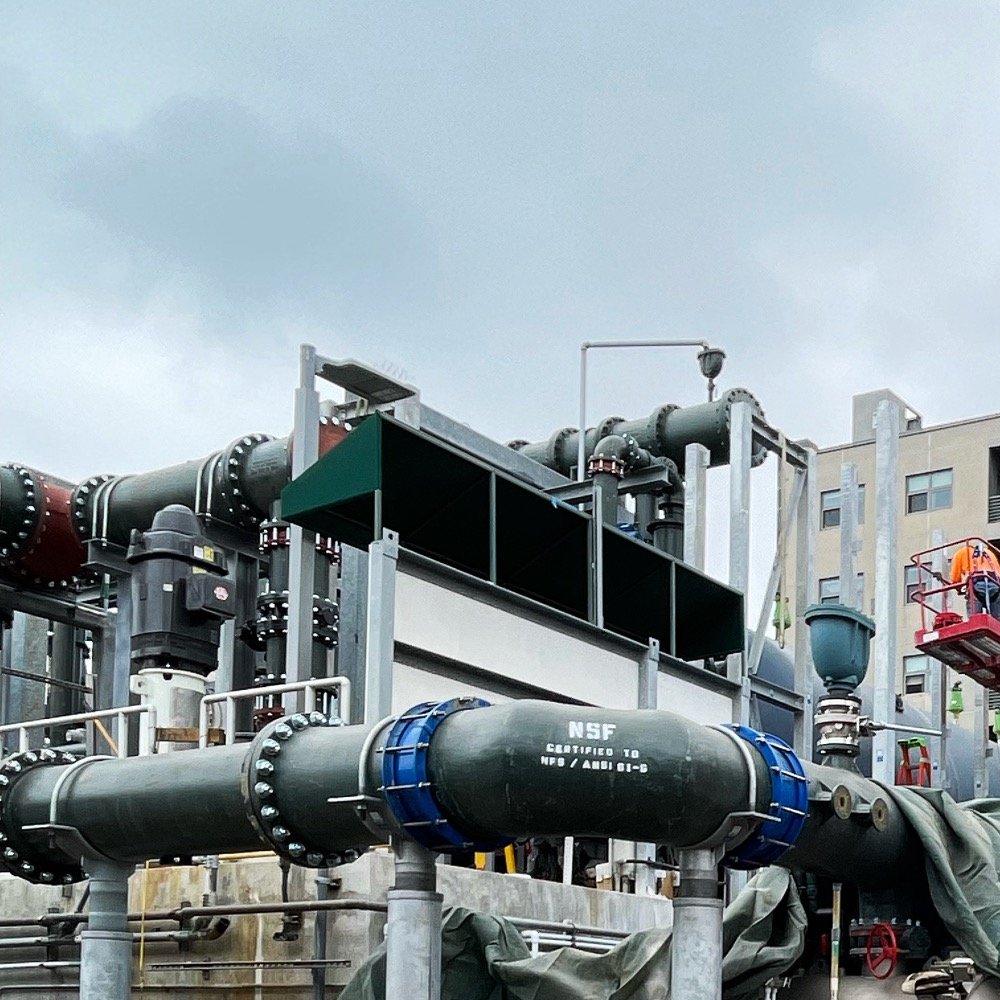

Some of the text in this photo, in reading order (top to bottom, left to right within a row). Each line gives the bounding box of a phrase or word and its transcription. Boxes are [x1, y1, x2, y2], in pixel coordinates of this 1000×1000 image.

[568, 721, 617, 740] NSF
[546, 743, 640, 759] CERTIFIED TO
